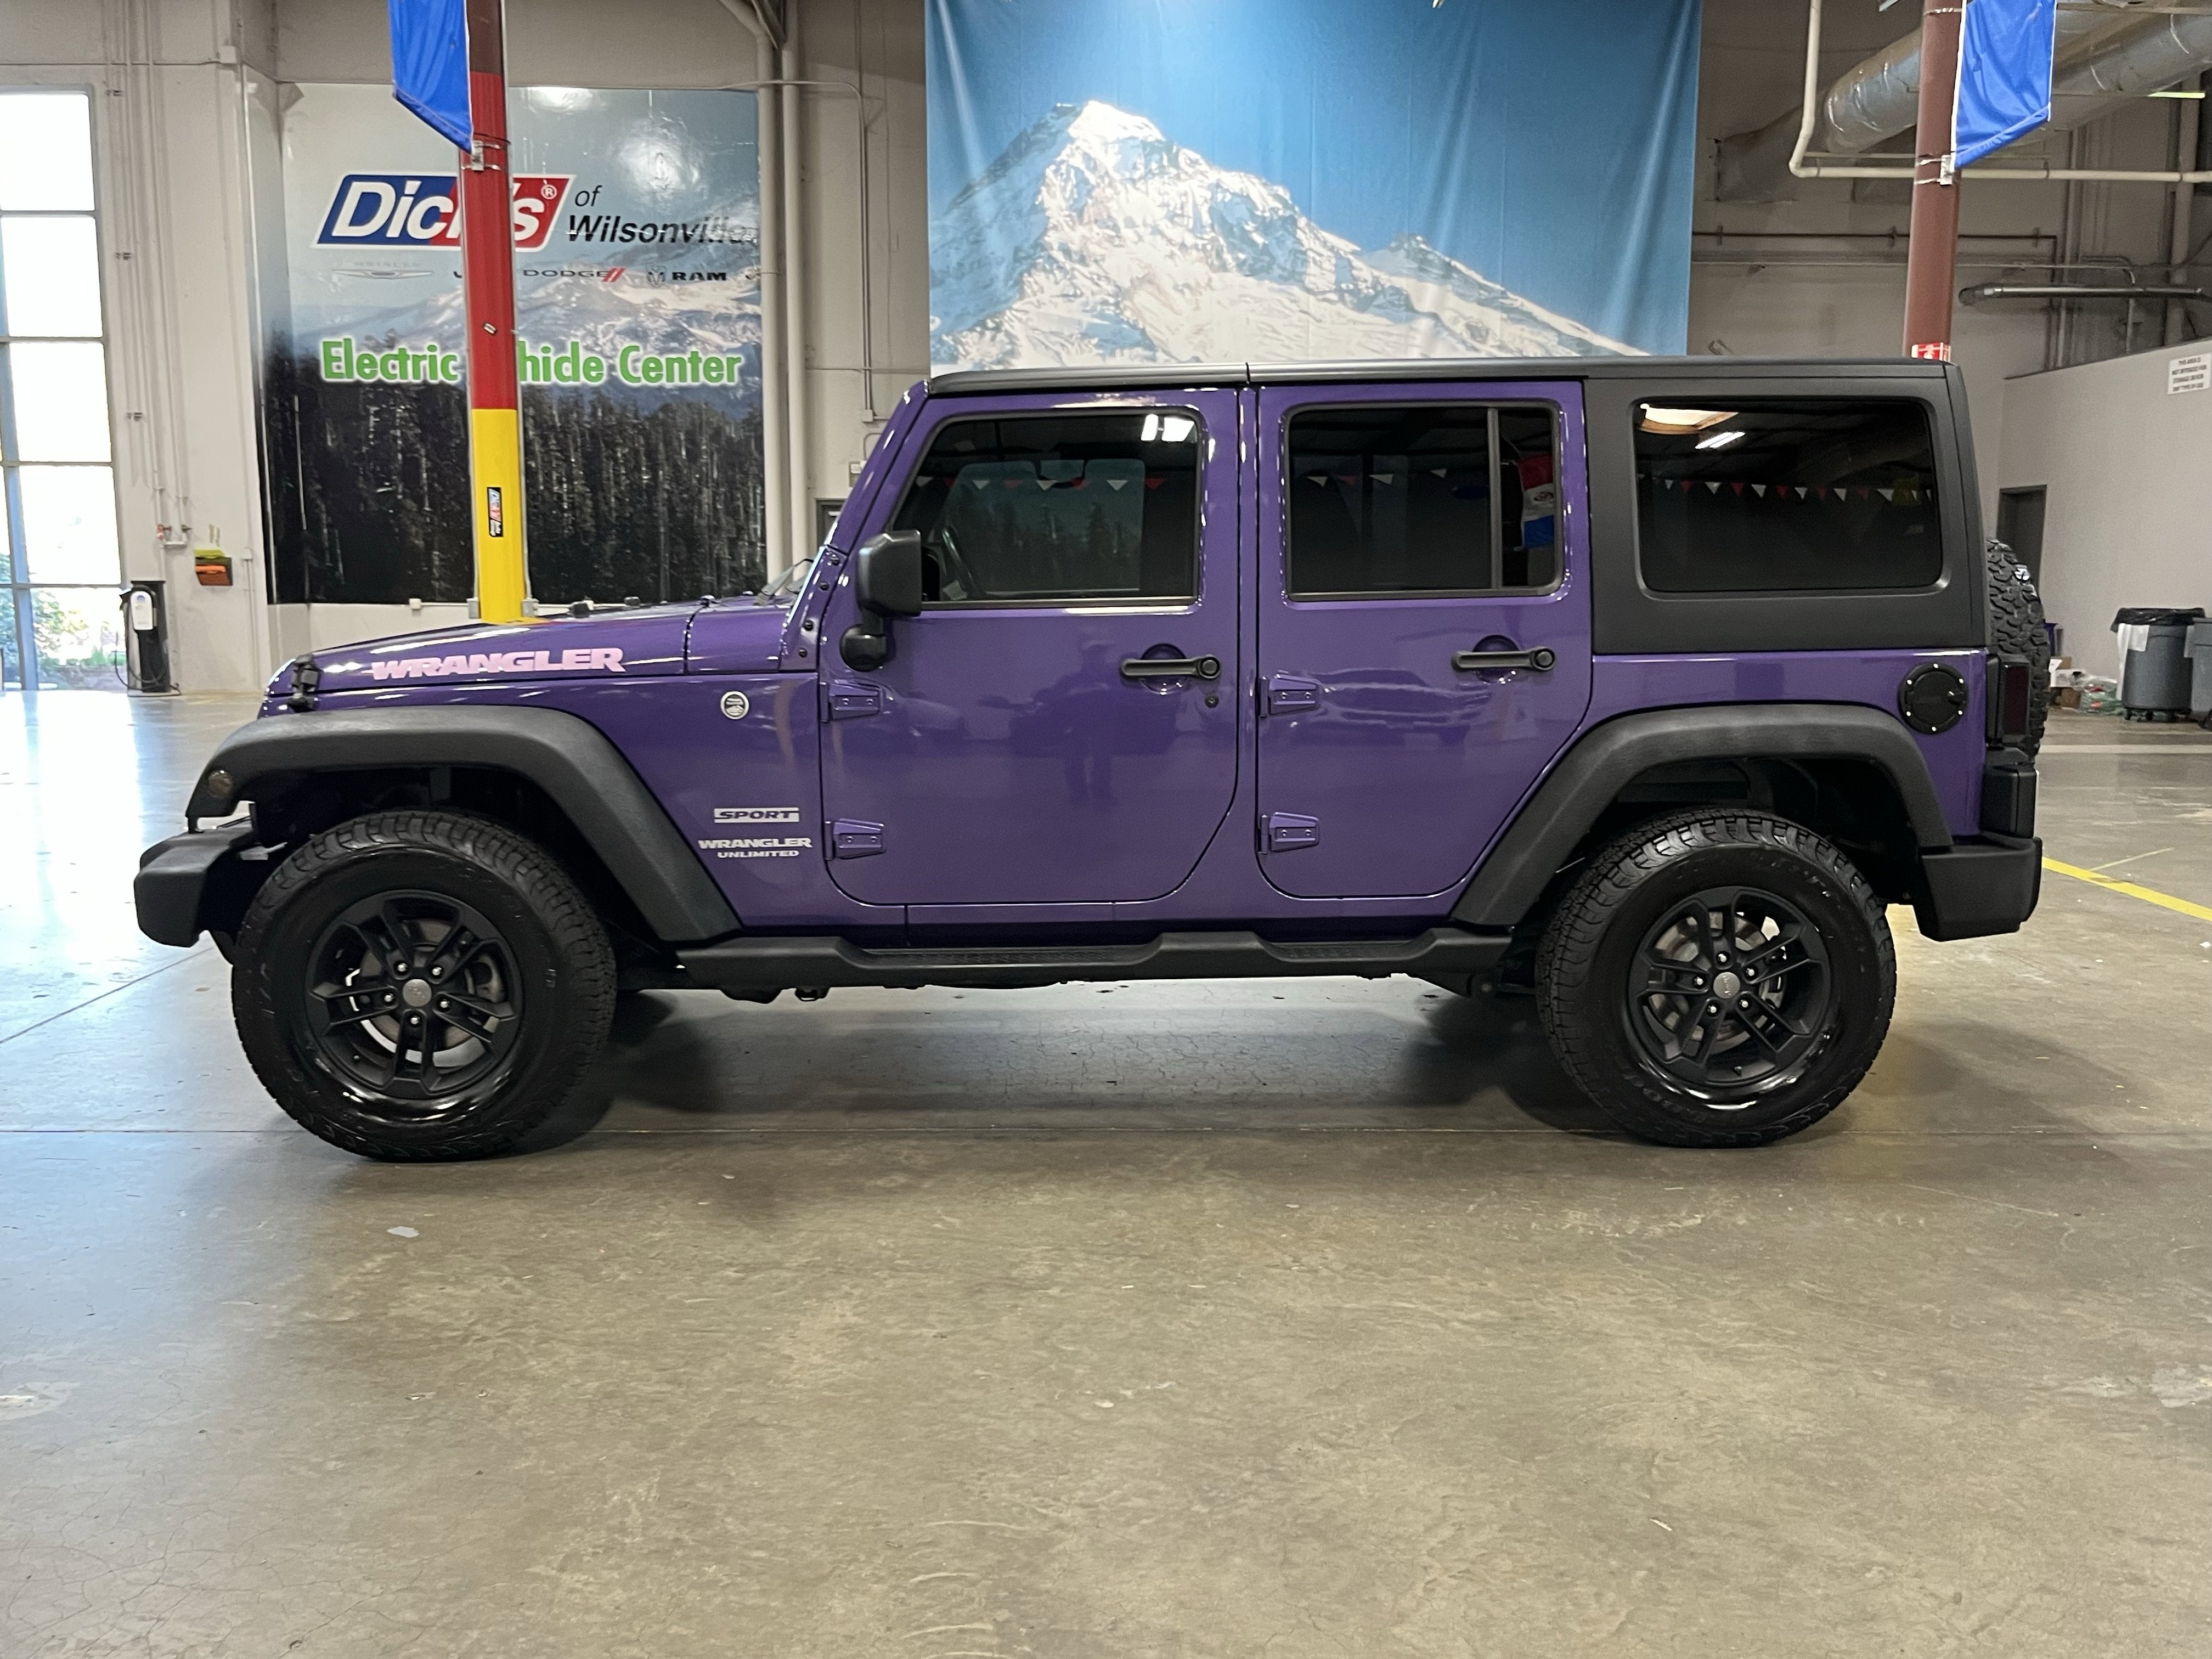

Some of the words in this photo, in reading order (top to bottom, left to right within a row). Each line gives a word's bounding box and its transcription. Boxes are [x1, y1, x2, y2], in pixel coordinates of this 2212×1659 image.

[574, 185, 602, 207] of
[331, 180, 544, 240] Dic's
[523, 269, 611, 278] DODGE
[672, 272, 727, 280] RAM
[322, 338, 458, 381] Electric
[518, 340, 604, 383] hicle
[619, 345, 742, 383] Center
[371, 647, 626, 680] WRANGLER
[715, 810, 798, 820] SPORT
[697, 838, 813, 849] WRANGLER
